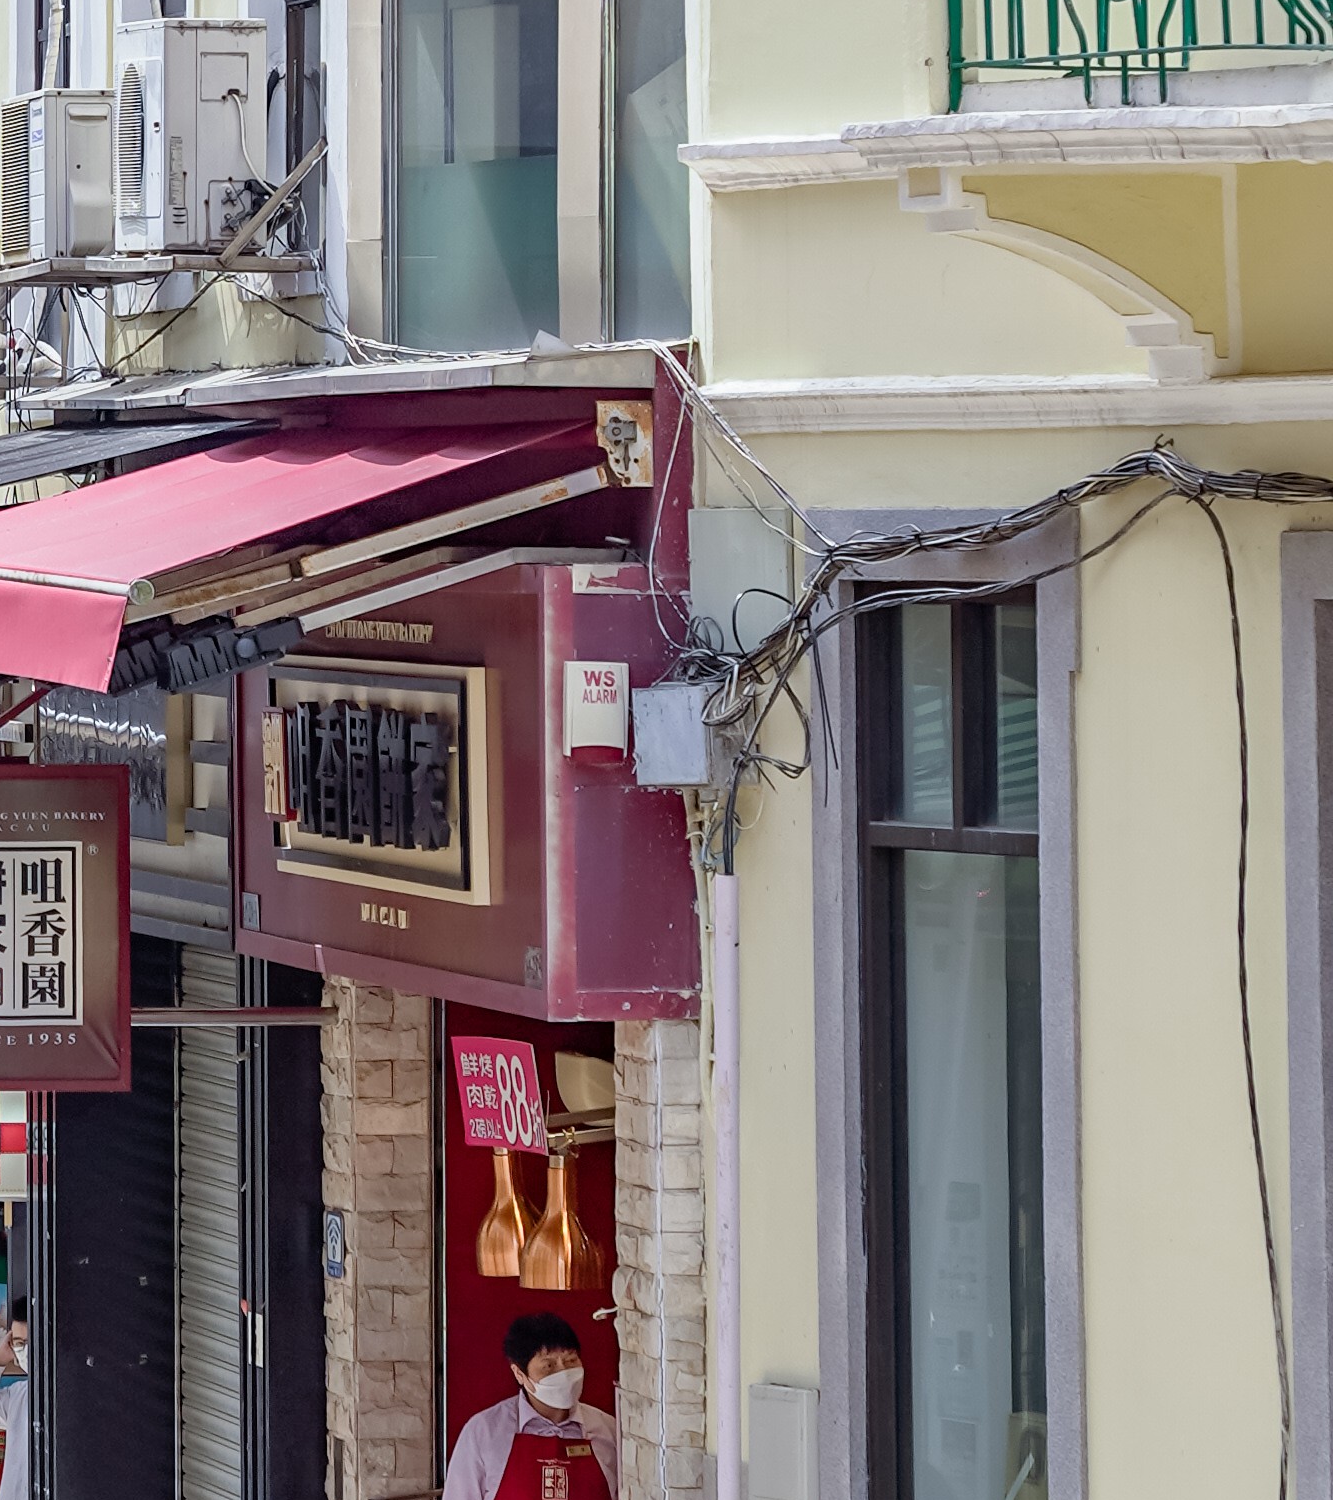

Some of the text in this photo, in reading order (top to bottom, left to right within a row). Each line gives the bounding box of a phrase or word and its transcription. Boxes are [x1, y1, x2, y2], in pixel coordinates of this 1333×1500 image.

[583, 670, 615, 687] WS
[583, 688, 617, 704] ALARM
[13, 812, 49, 821] YUEN
[54, 812, 106, 821] BAKERY
[360, 902, 408, 930] MACAU
[21, 858, 66, 1008] 咀香園
[27, 1033, 77, 1045] 1935
[460, 1052, 493, 1079] 鮮烤
[466, 1083, 498, 1110] 肉乾
